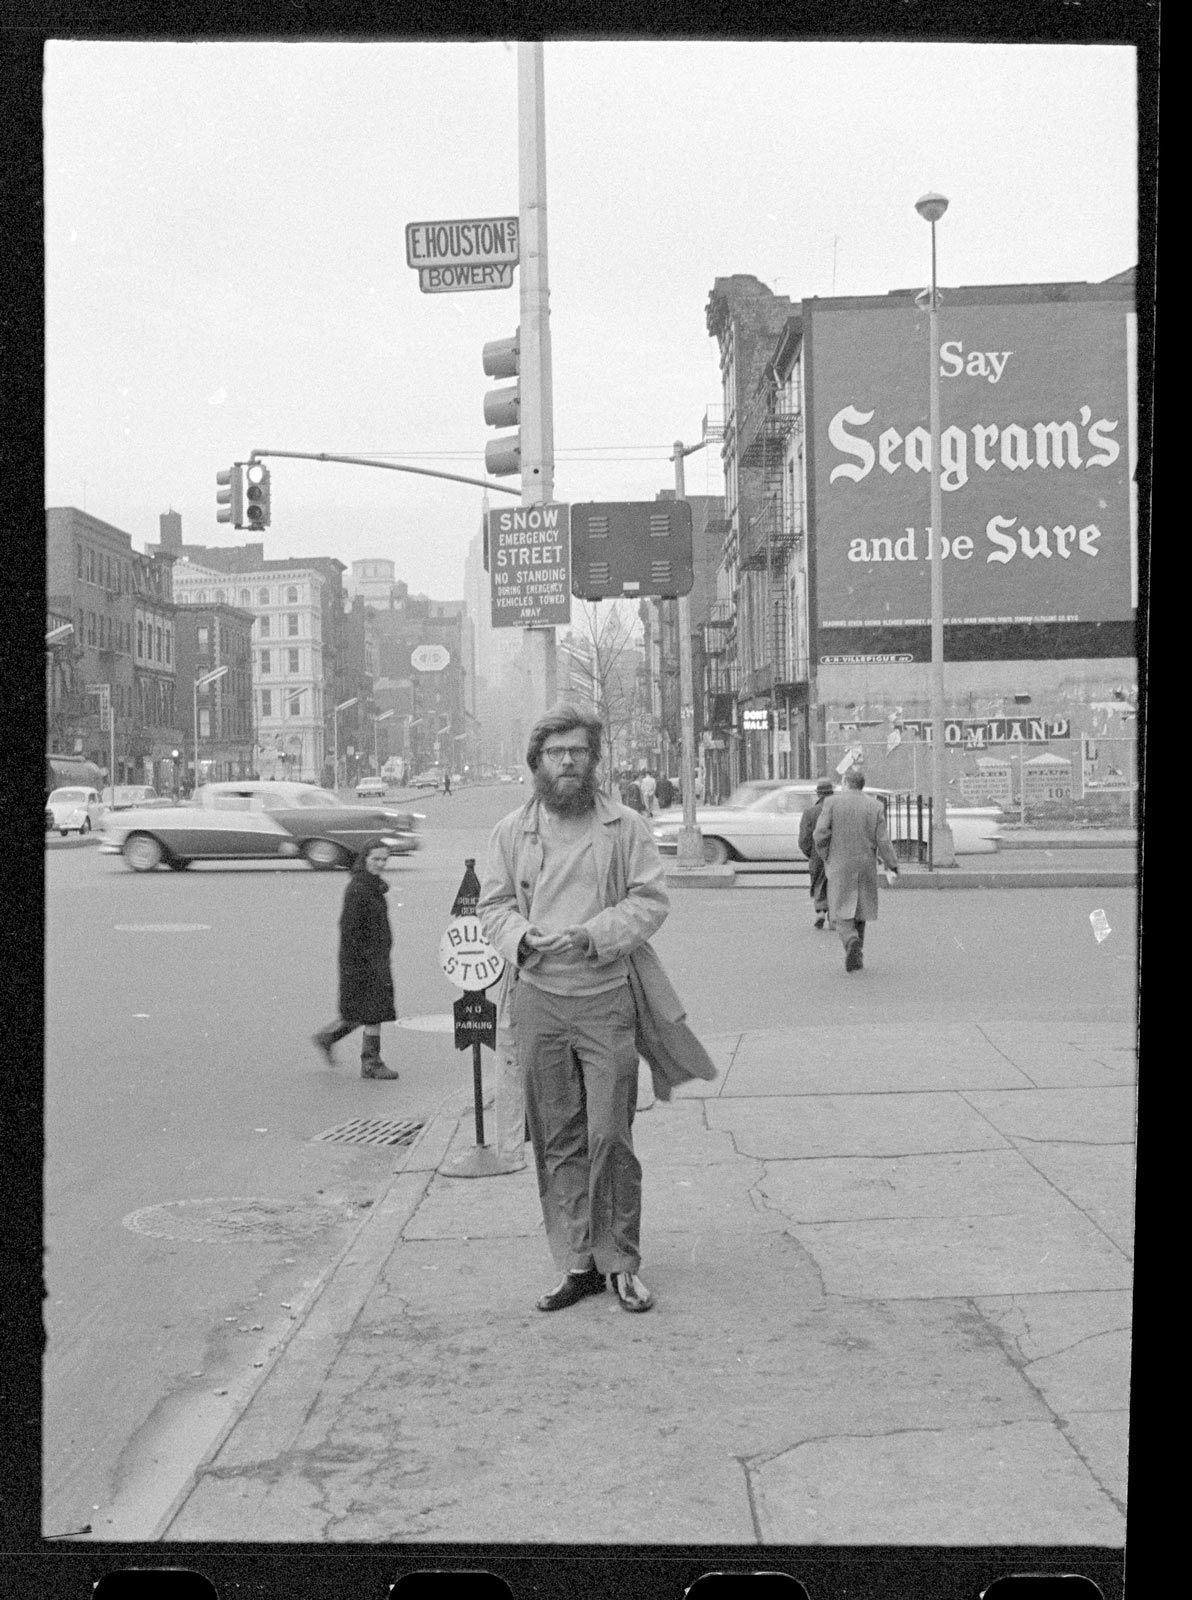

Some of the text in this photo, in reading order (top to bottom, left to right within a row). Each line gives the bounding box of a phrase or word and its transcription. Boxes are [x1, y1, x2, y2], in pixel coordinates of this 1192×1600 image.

[429, 264, 508, 287] BOWERY
[939, 341, 1014, 384] Say
[828, 404, 1121, 492] Seagram's
[500, 509, 558, 531] SNOW
[499, 530, 559, 546] EMERGENCY
[848, 515, 1102, 564] and be Sure
[497, 545, 563, 567] STREET
[494, 568, 566, 585] NO STANDING
[498, 583, 563, 596] DURING EMERGENCY
[496, 594, 565, 608] VEHICLES TOWED
[520, 607, 541, 618] AWAY
[743, 710, 768, 720] DONT
[743, 720, 768, 730] WALK
[443, 955, 500, 981] STOP
[465, 1005, 482, 1014] NO
[455, 1021, 492, 1030] PARKING
